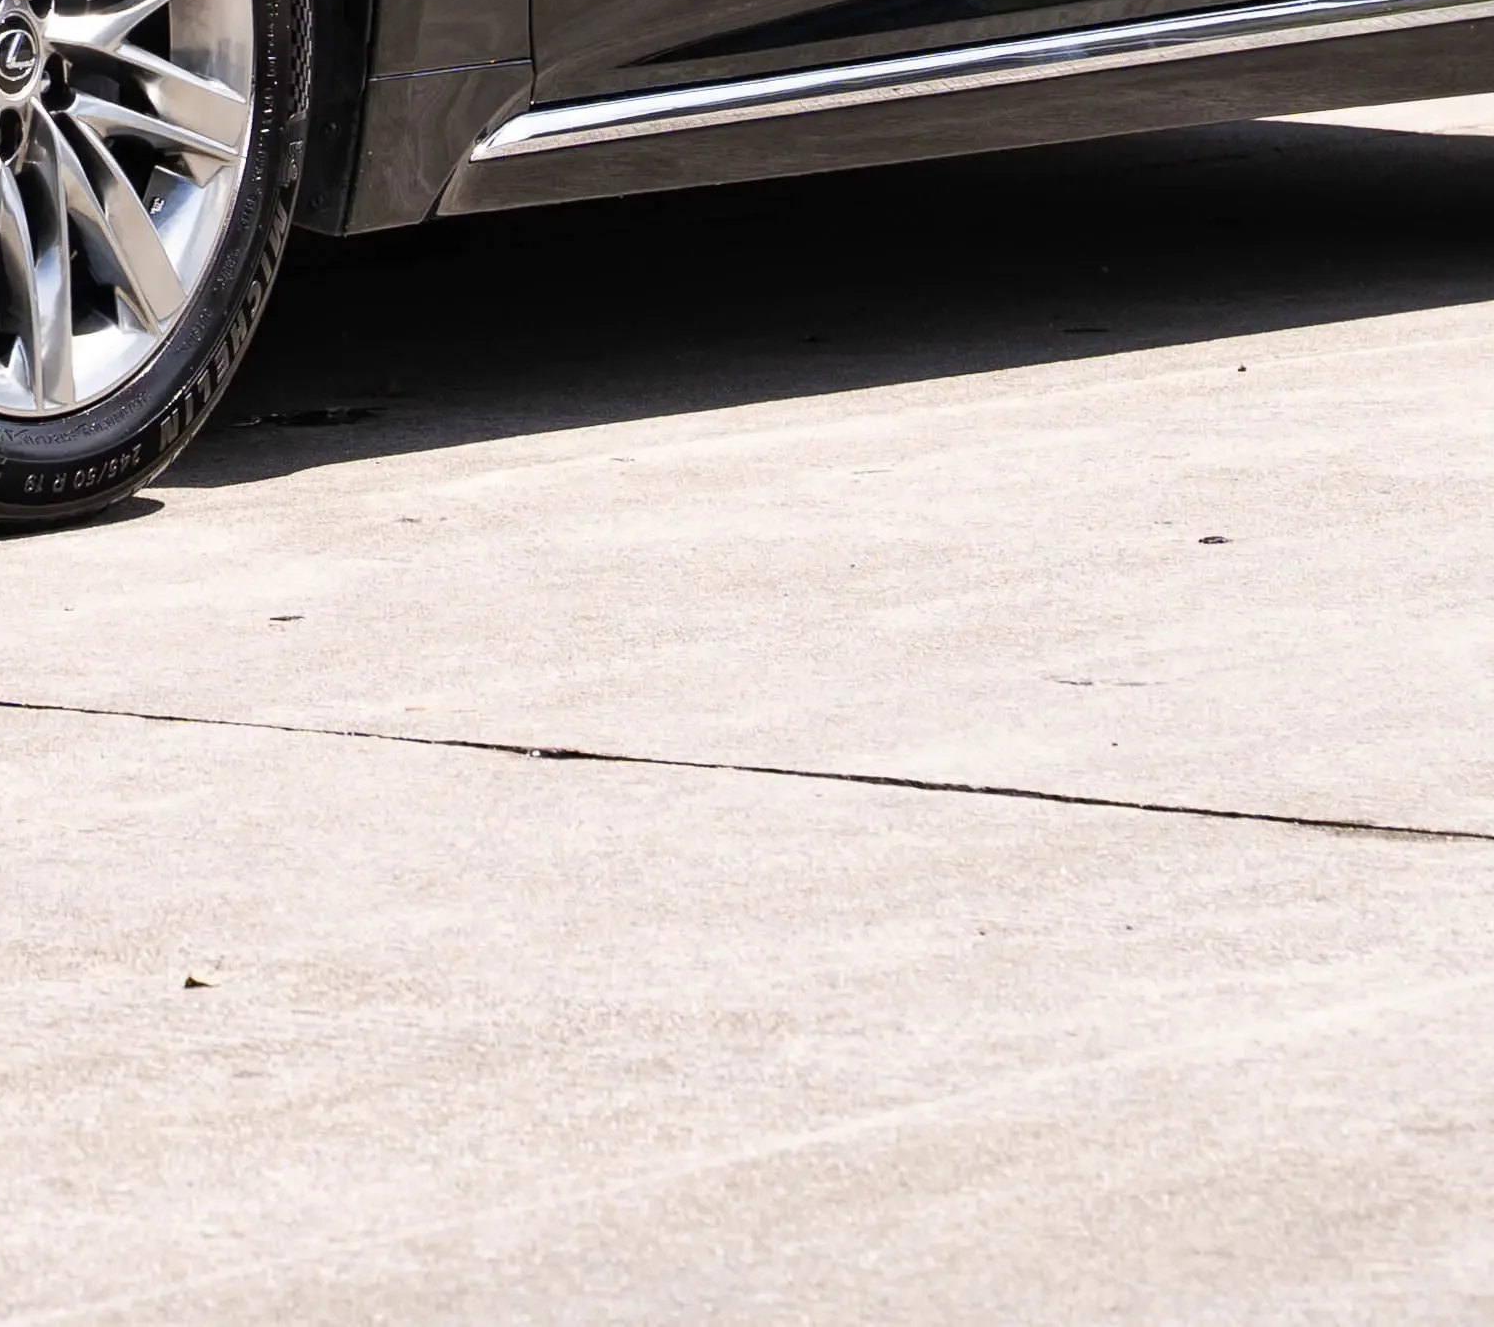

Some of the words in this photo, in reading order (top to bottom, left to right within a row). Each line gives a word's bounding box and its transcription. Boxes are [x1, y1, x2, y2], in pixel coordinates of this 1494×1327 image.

[156, 198, 290, 454] MICHELIN
[24, 473, 45, 494] 19
[52, 472, 67, 493] R
[73, 443, 143, 490] 245/50
